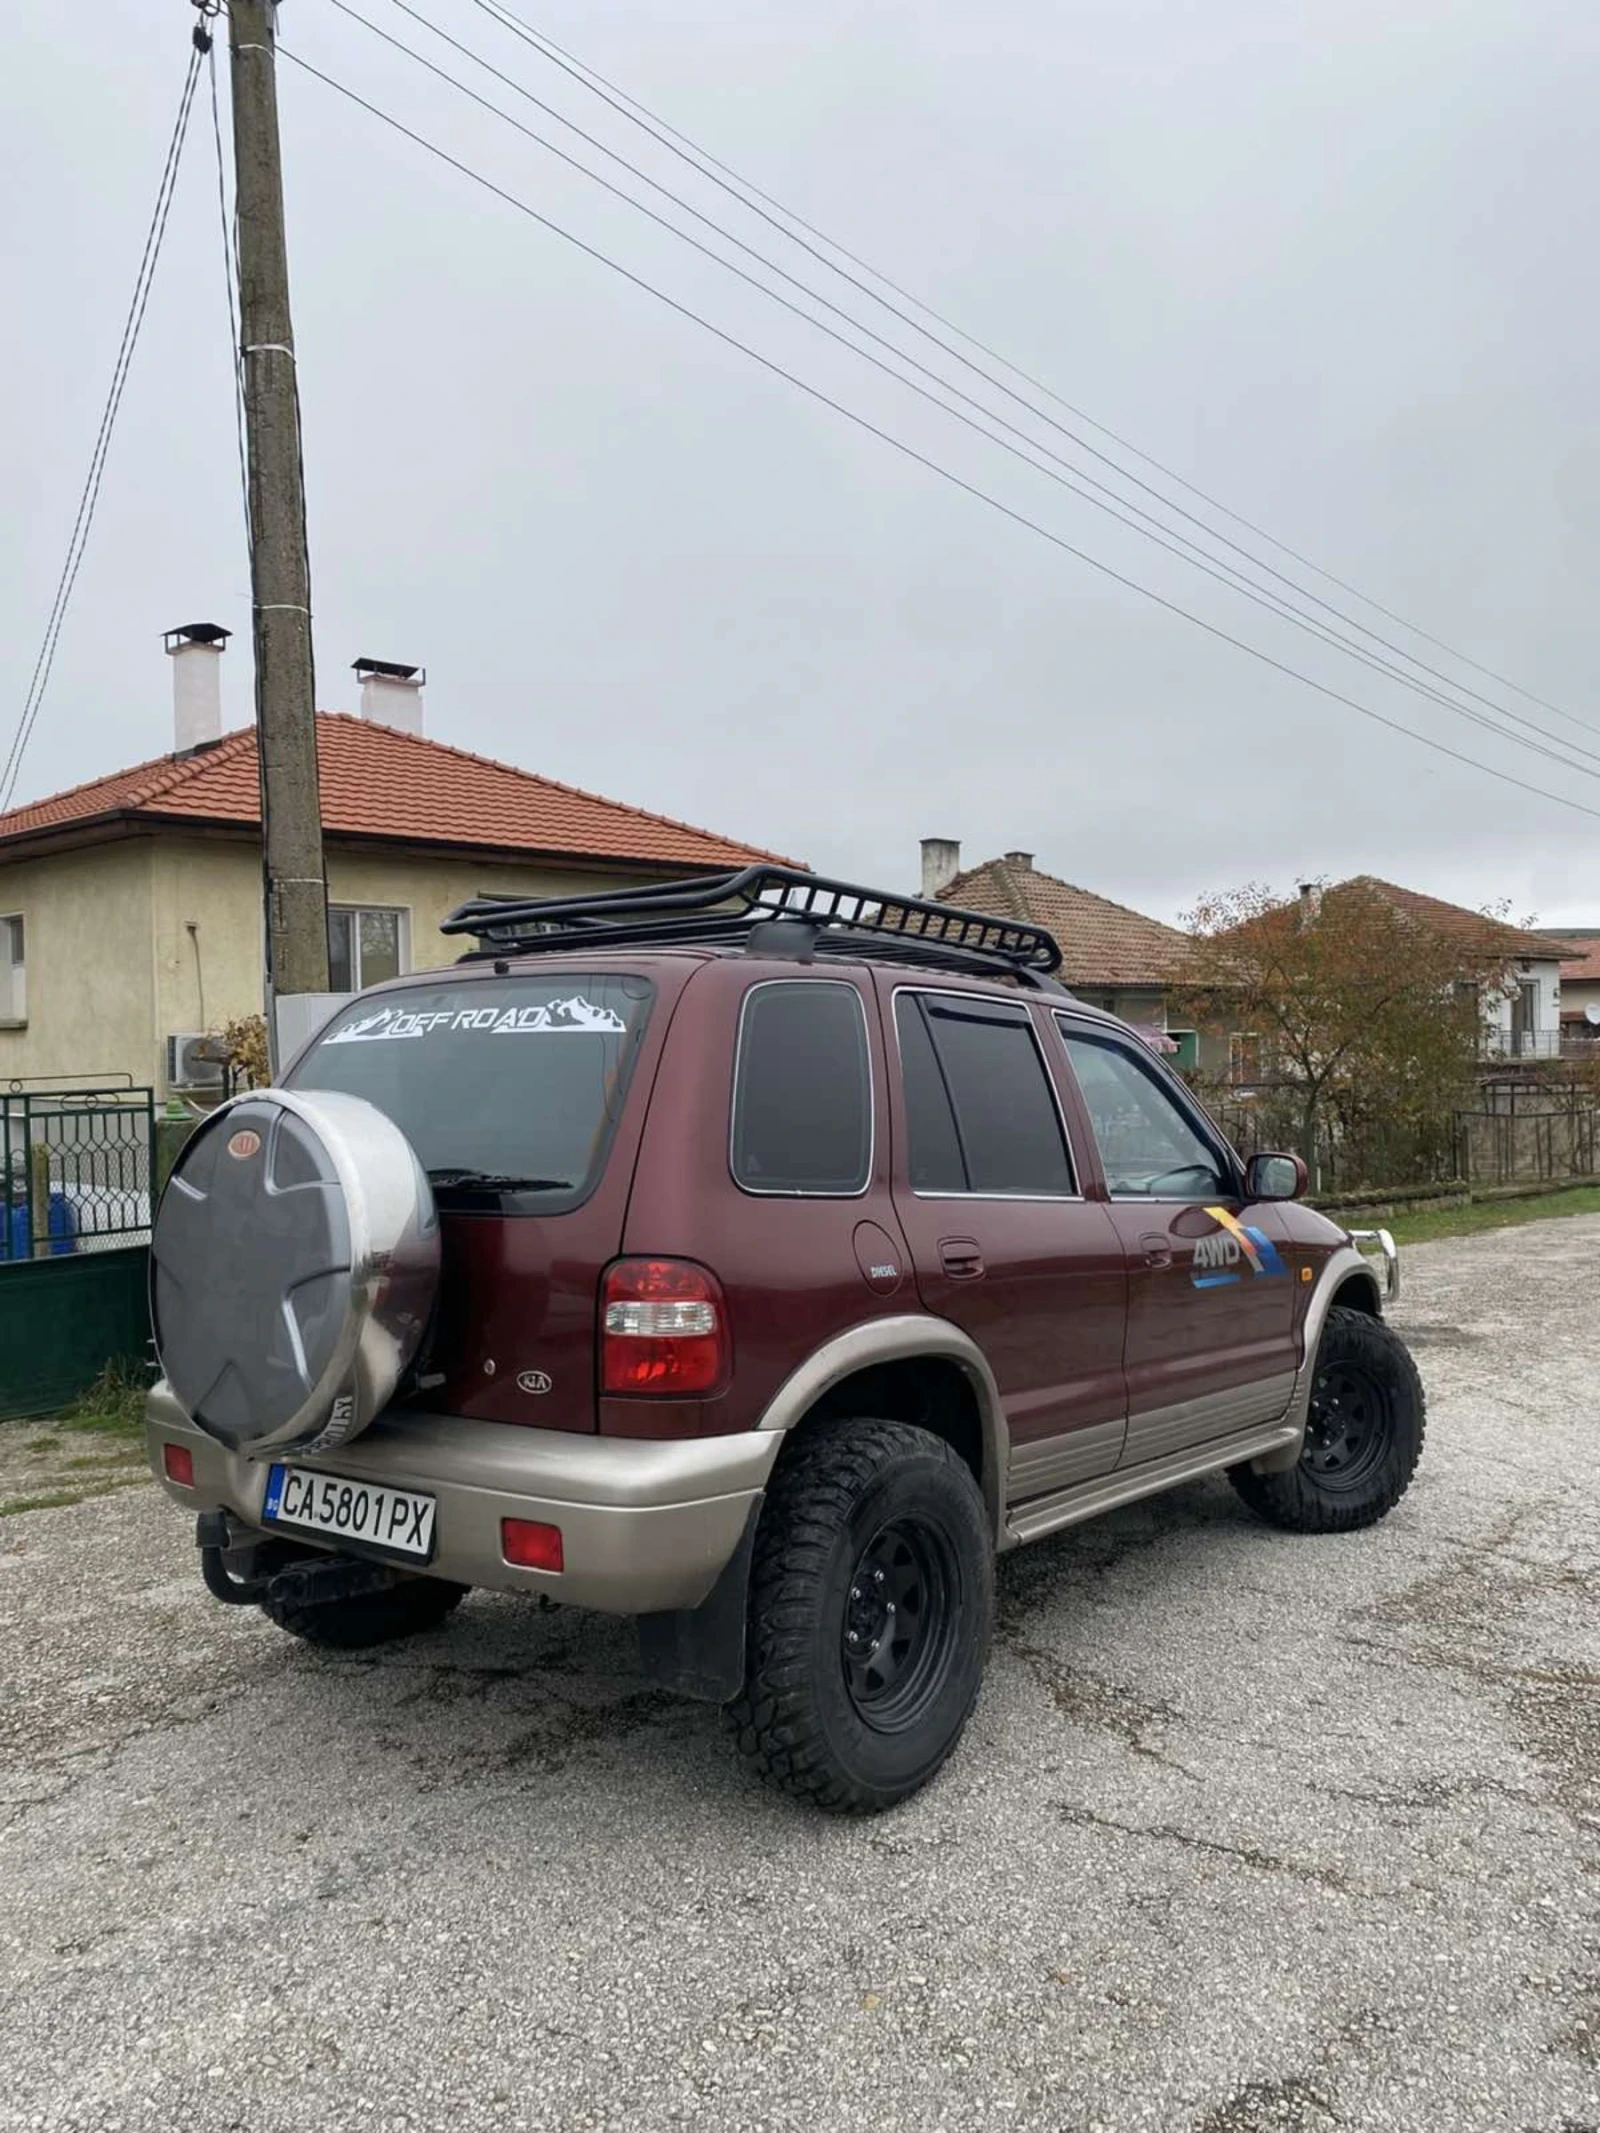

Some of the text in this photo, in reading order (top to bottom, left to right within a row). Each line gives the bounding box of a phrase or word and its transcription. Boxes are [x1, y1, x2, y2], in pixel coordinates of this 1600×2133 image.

[393, 1006, 545, 1033] OFF ROAD
[1193, 1237, 1240, 1268] 4WD
